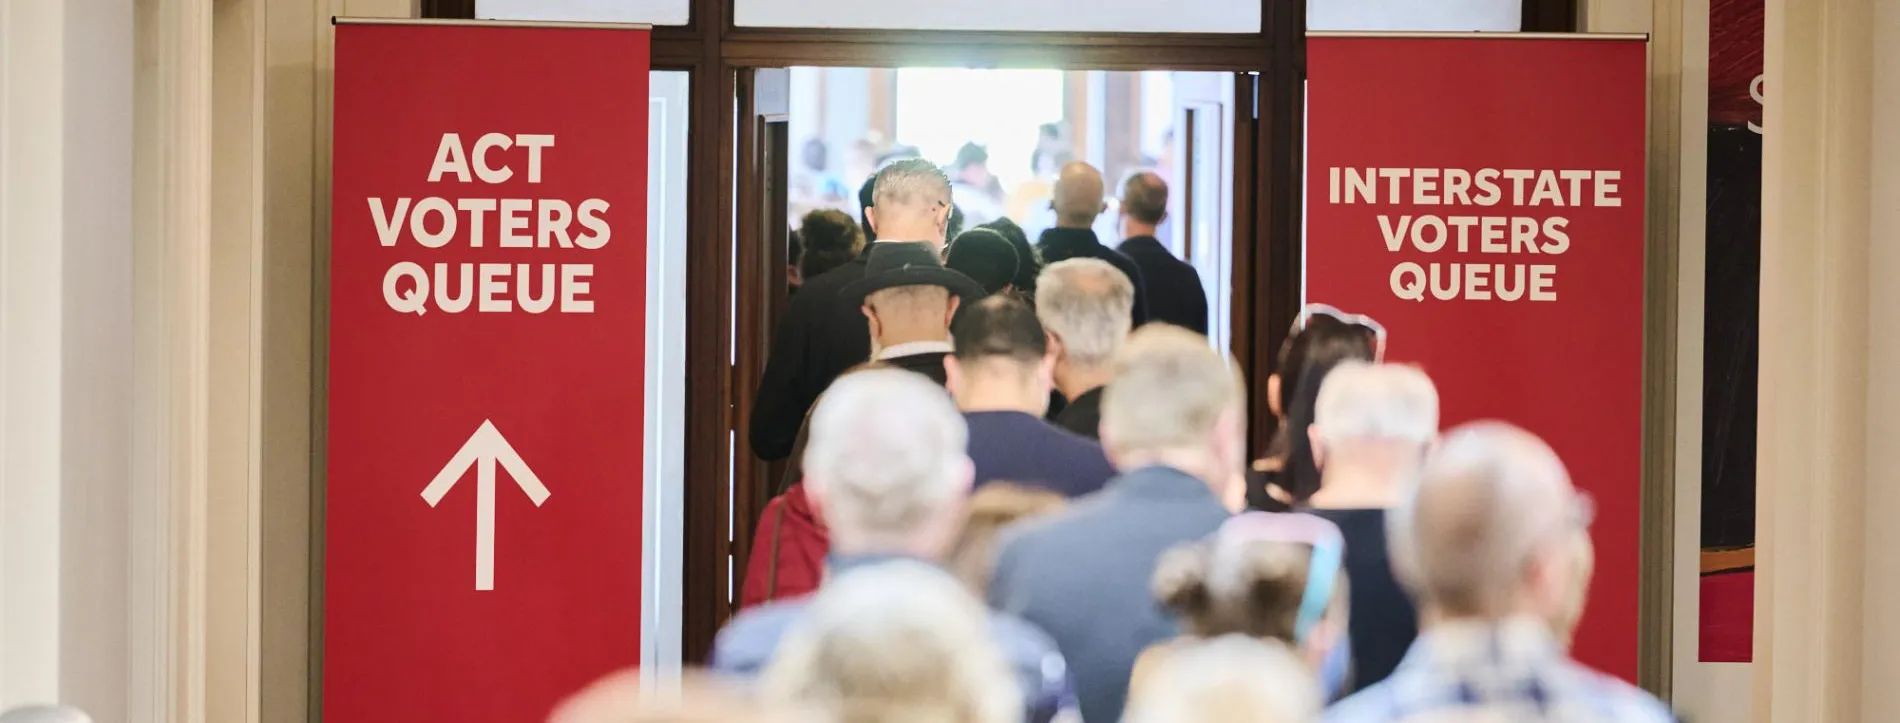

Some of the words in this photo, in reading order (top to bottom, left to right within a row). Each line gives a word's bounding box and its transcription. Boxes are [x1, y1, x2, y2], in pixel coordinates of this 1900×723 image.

[427, 132, 555, 184] ACT
[1329, 166, 1622, 207] INTERSTATE
[367, 197, 611, 250] VOTERS
[1376, 214, 1570, 255] VOTERS
[382, 261, 596, 316] QUEUE
[1389, 261, 1557, 303] QUEUE
